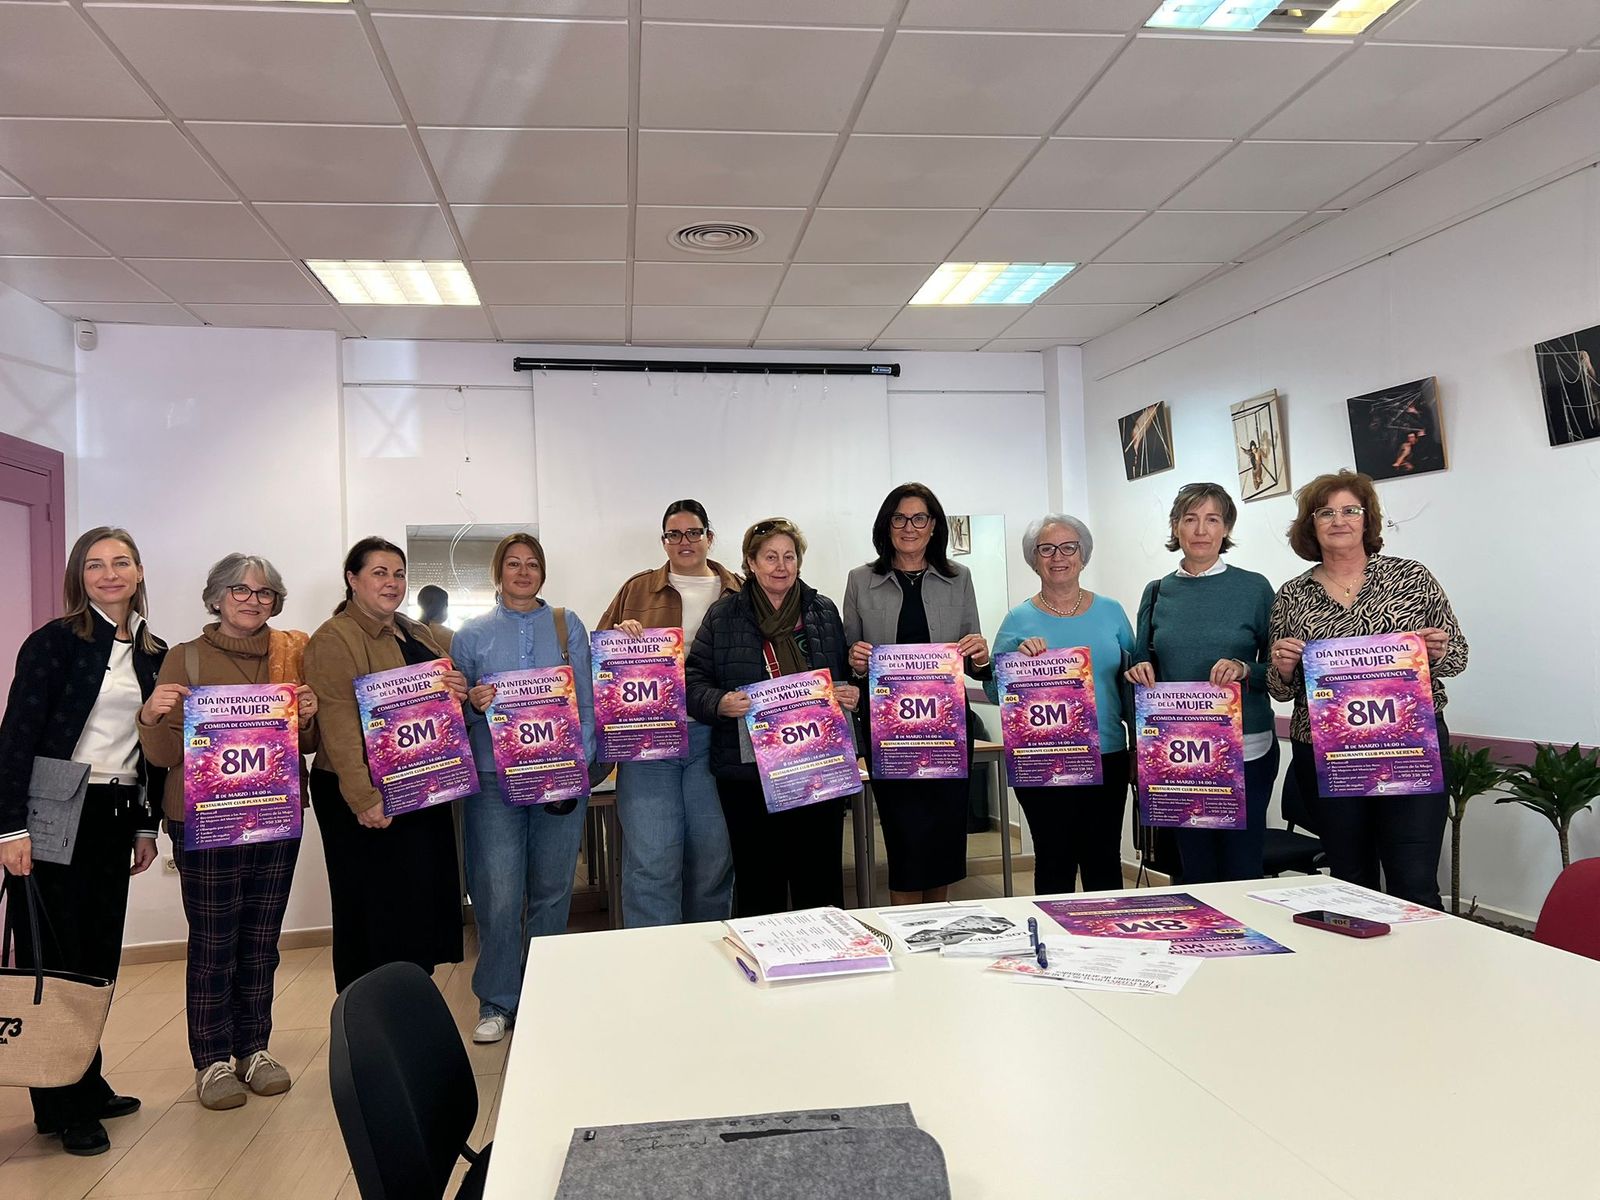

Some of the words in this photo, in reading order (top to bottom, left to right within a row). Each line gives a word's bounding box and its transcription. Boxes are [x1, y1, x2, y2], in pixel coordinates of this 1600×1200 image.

[616, 636, 672, 645] INTERNACIONAL
[628, 644, 660, 655] MUJER
[1316, 649, 1332, 658] DÍA
[1335, 644, 1411, 657] INTERNACIONAL
[905, 661, 939, 671] MUJER
[1020, 657, 1079, 667] INTERNACIONAL
[1351, 654, 1396, 668] MUJER
[1032, 666, 1067, 677] MUJER
[1362, 670, 1407, 679] CONVIVENCIA
[366, 682, 381, 692] DÍA
[382, 669, 442, 688] INTERNACIONAL
[507, 676, 563, 688] INTERNACIONAL
[396, 680, 432, 697] MUJER
[519, 684, 552, 697] MUJER
[622, 680, 658, 703] 8M
[751, 690, 764, 699] DÍA
[765, 679, 821, 696] INTERNACIONAL
[778, 688, 812, 702] MUJER
[198, 696, 214, 705] DÍA
[216, 695, 285, 704] INTERNACIONAL
[377, 703, 400, 712] COMIDA
[407, 692, 441, 705] CONVIVENCIA
[528, 698, 561, 706] CONVIVENCIA
[1176, 701, 1214, 710] MUJER
[231, 704, 270, 716] MUJER
[761, 708, 782, 716] COMIDA
[788, 699, 822, 709] CONVIVENCIA
[899, 698, 936, 719] 8M
[1029, 703, 1067, 726] 8M
[1346, 698, 1396, 726] 8M
[370, 720, 383, 729] 40€
[396, 718, 436, 749] 8M
[518, 721, 554, 745] 8M
[780, 721, 820, 746] 8M
[1169, 740, 1210, 763] 8M
[221, 747, 265, 775] 8M
[1114, 918, 1188, 932] 8M
